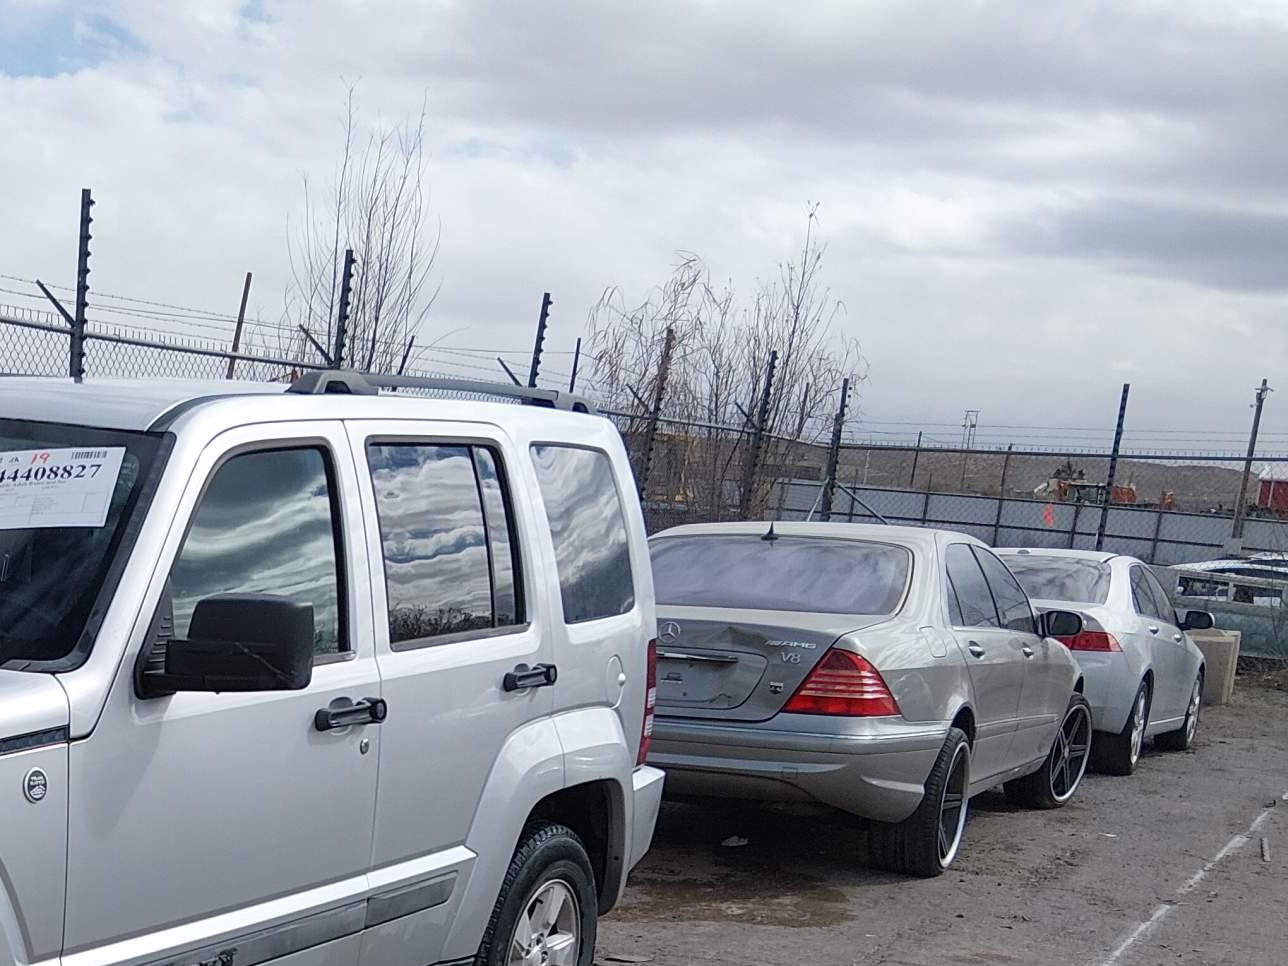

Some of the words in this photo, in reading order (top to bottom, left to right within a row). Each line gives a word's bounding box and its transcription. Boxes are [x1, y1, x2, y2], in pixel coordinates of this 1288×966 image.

[31, 451, 49, 463] 19
[780, 640, 816, 649] AMG
[781, 651, 801, 664] V8
